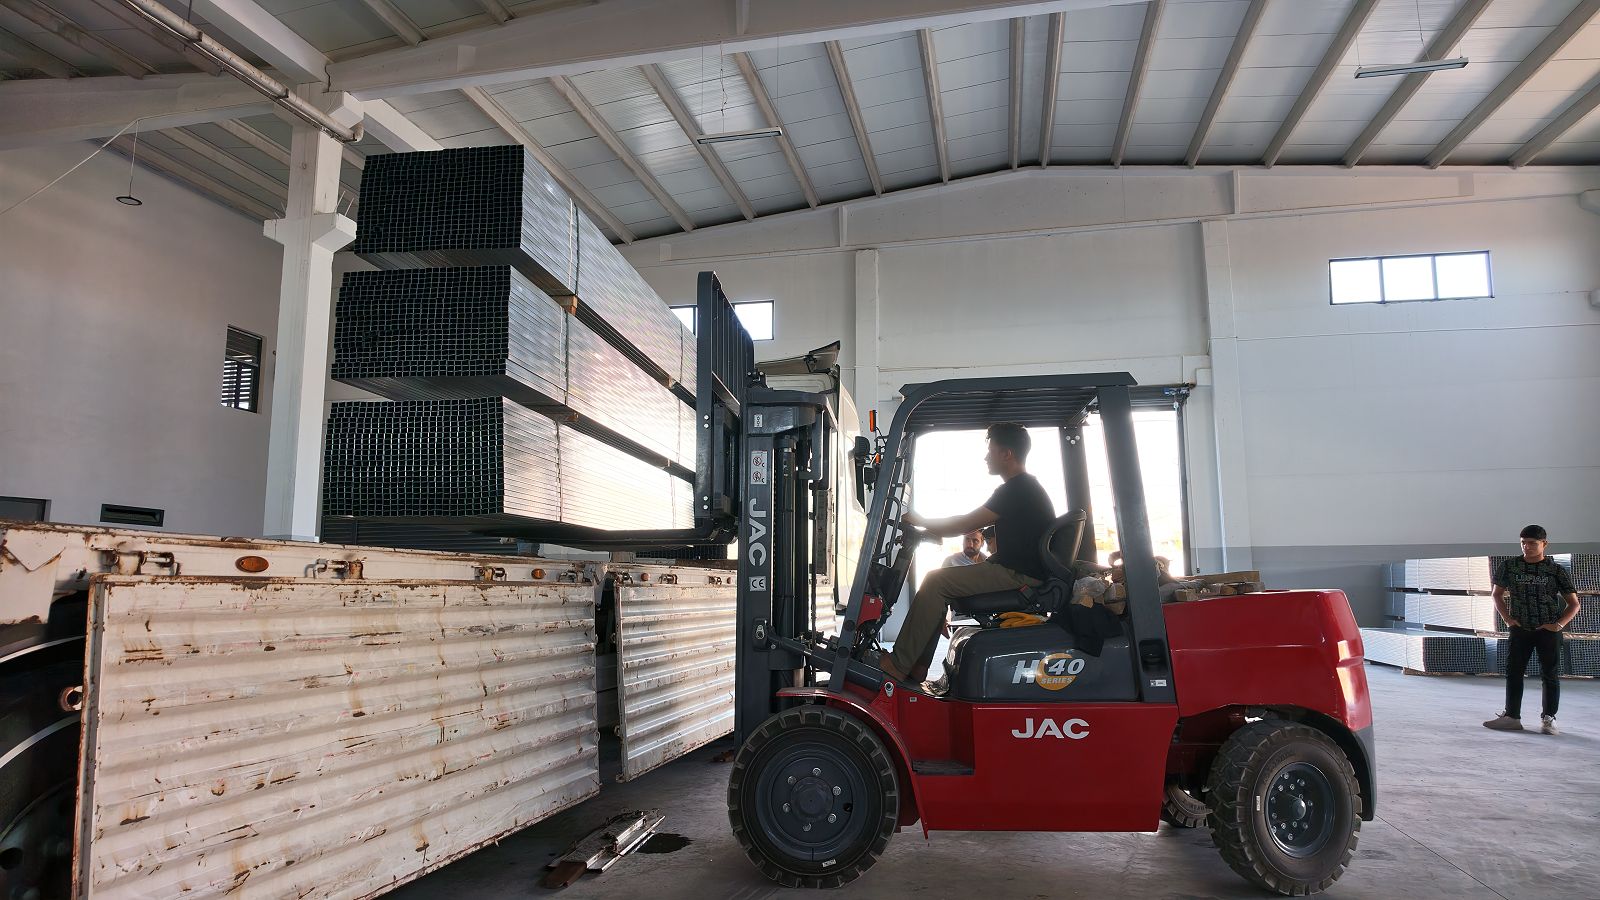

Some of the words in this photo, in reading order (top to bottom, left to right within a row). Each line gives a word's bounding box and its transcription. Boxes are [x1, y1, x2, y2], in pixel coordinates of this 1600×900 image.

[749, 498, 767, 566] JAC
[751, 578, 765, 589] CE
[1041, 677, 1073, 685] SERIES
[1011, 717, 1090, 740] JAC
